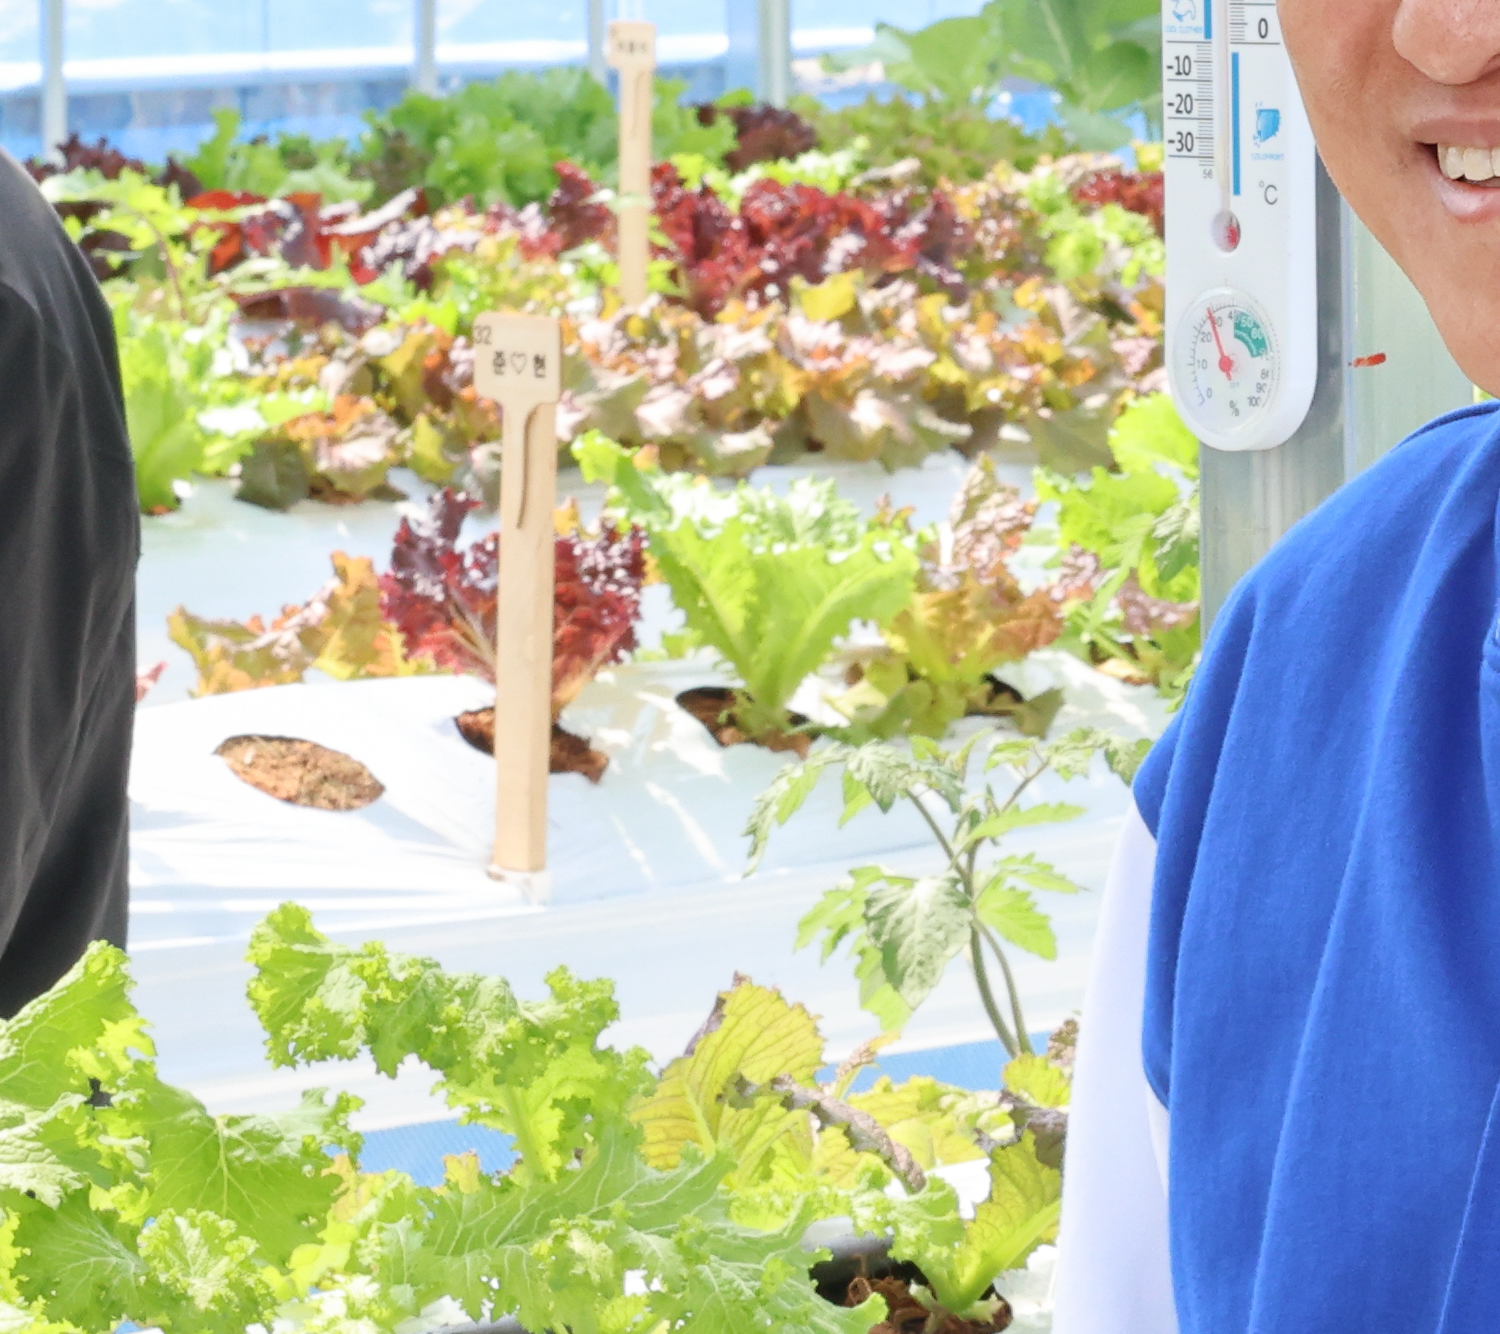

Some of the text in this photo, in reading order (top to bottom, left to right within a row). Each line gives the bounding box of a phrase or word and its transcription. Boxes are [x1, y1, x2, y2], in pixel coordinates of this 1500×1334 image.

[1258, 18, 1269, 39] 0
[1166, 55, 1192, 76] -10
[1167, 93, 1194, 115] -20
[1167, 131, 1195, 153] -30
[1200, 331, 1212, 343] 20
[1197, 358, 1208, 370] 10
